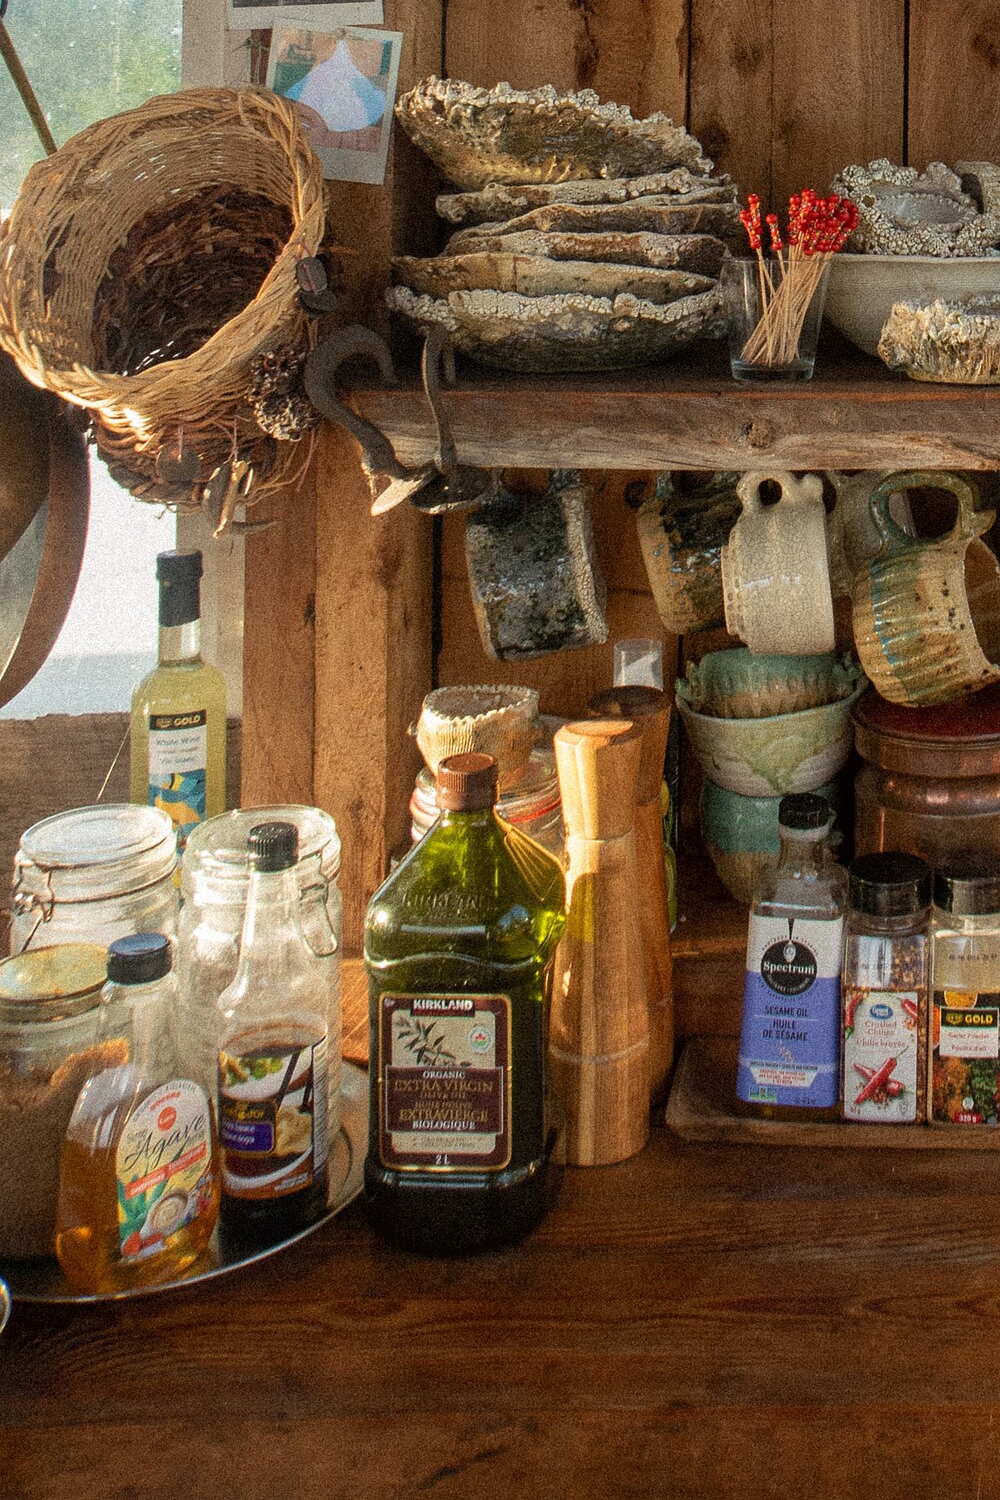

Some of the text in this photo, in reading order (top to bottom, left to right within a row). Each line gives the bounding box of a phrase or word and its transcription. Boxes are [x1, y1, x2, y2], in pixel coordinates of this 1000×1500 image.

[174, 714, 201, 727] GOLD
[762, 960, 815, 975] Spectrum
[412, 999, 474, 1010] KIRKLAND
[764, 1004, 809, 1018] SESAME OIL
[772, 1019, 797, 1030] HUILE
[964, 1013, 994, 1024] GOLD
[422, 1070, 466, 1080] ORGANIC
[394, 1079, 494, 1093] EXTRA VIRGIN
[411, 1120, 477, 1131] BIOLOGIQUE
[123, 1113, 205, 1173] Agave
